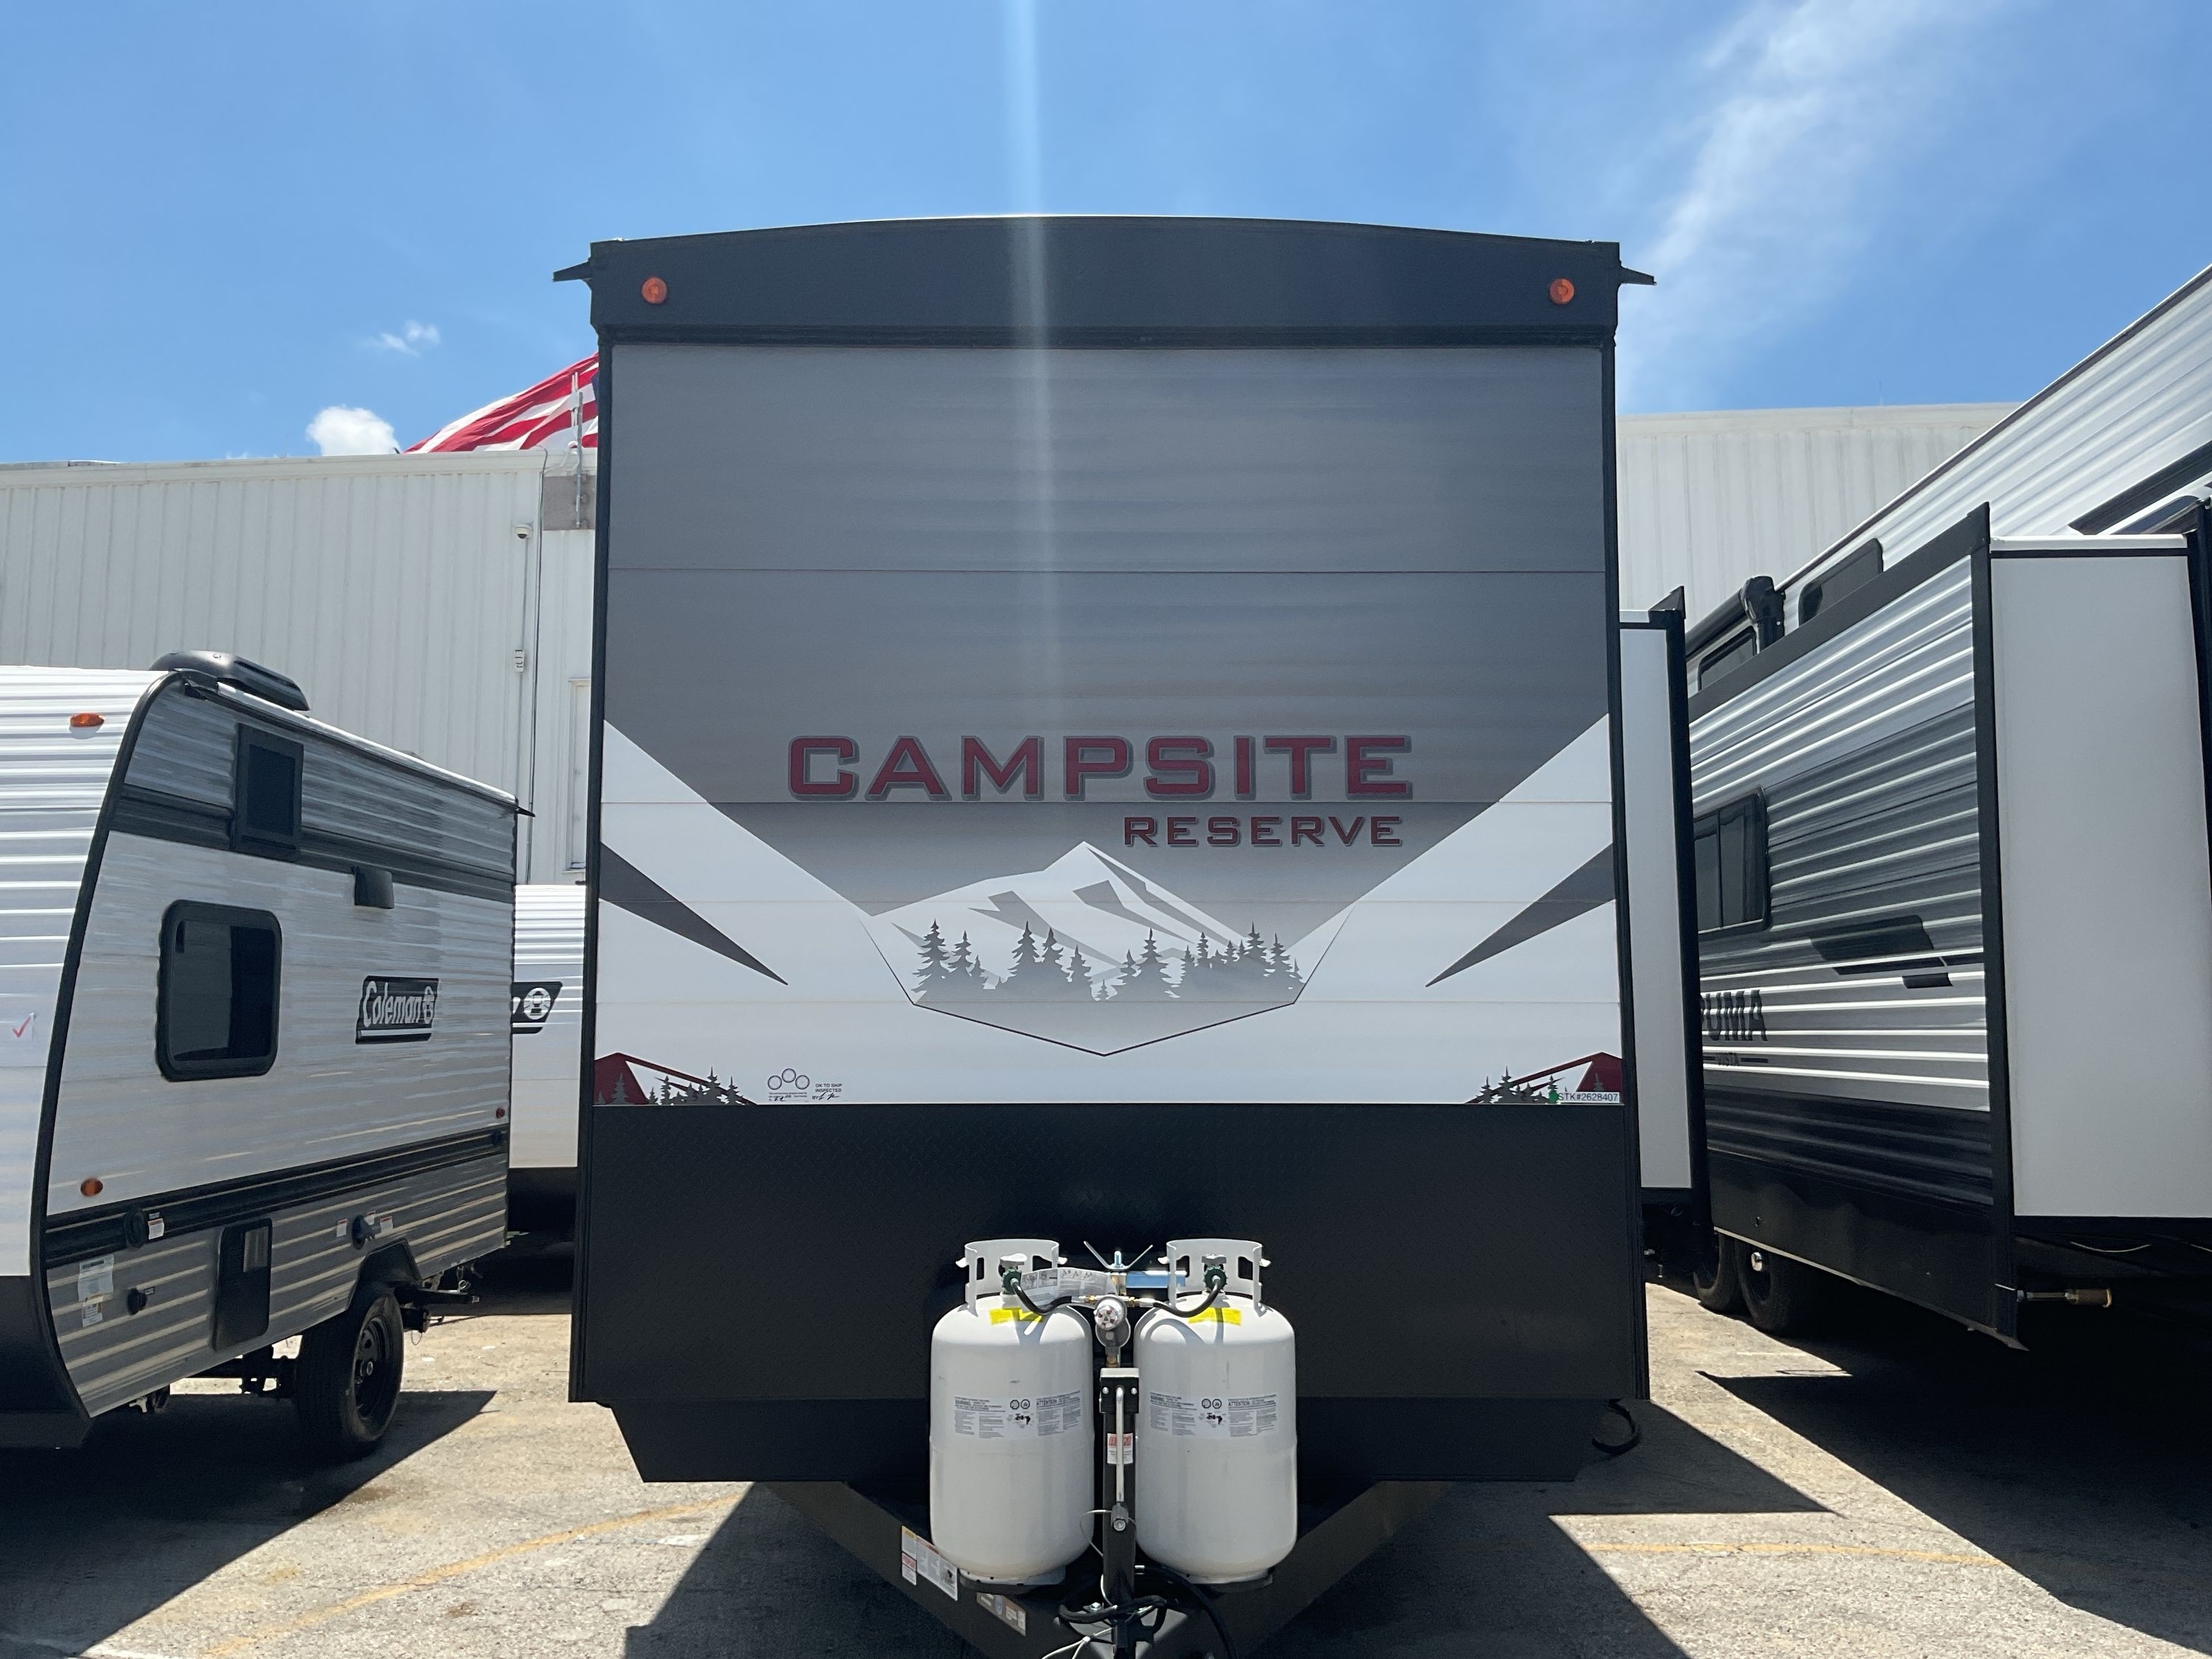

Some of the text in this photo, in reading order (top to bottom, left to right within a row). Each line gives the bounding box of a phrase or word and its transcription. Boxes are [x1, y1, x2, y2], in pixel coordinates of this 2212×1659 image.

[788, 735, 1412, 801] CAMPSITE
[1124, 815, 1402, 846] RESERVE
[363, 981, 422, 1027] Coleman
[1558, 1093, 1618, 1102] STK#2628407
